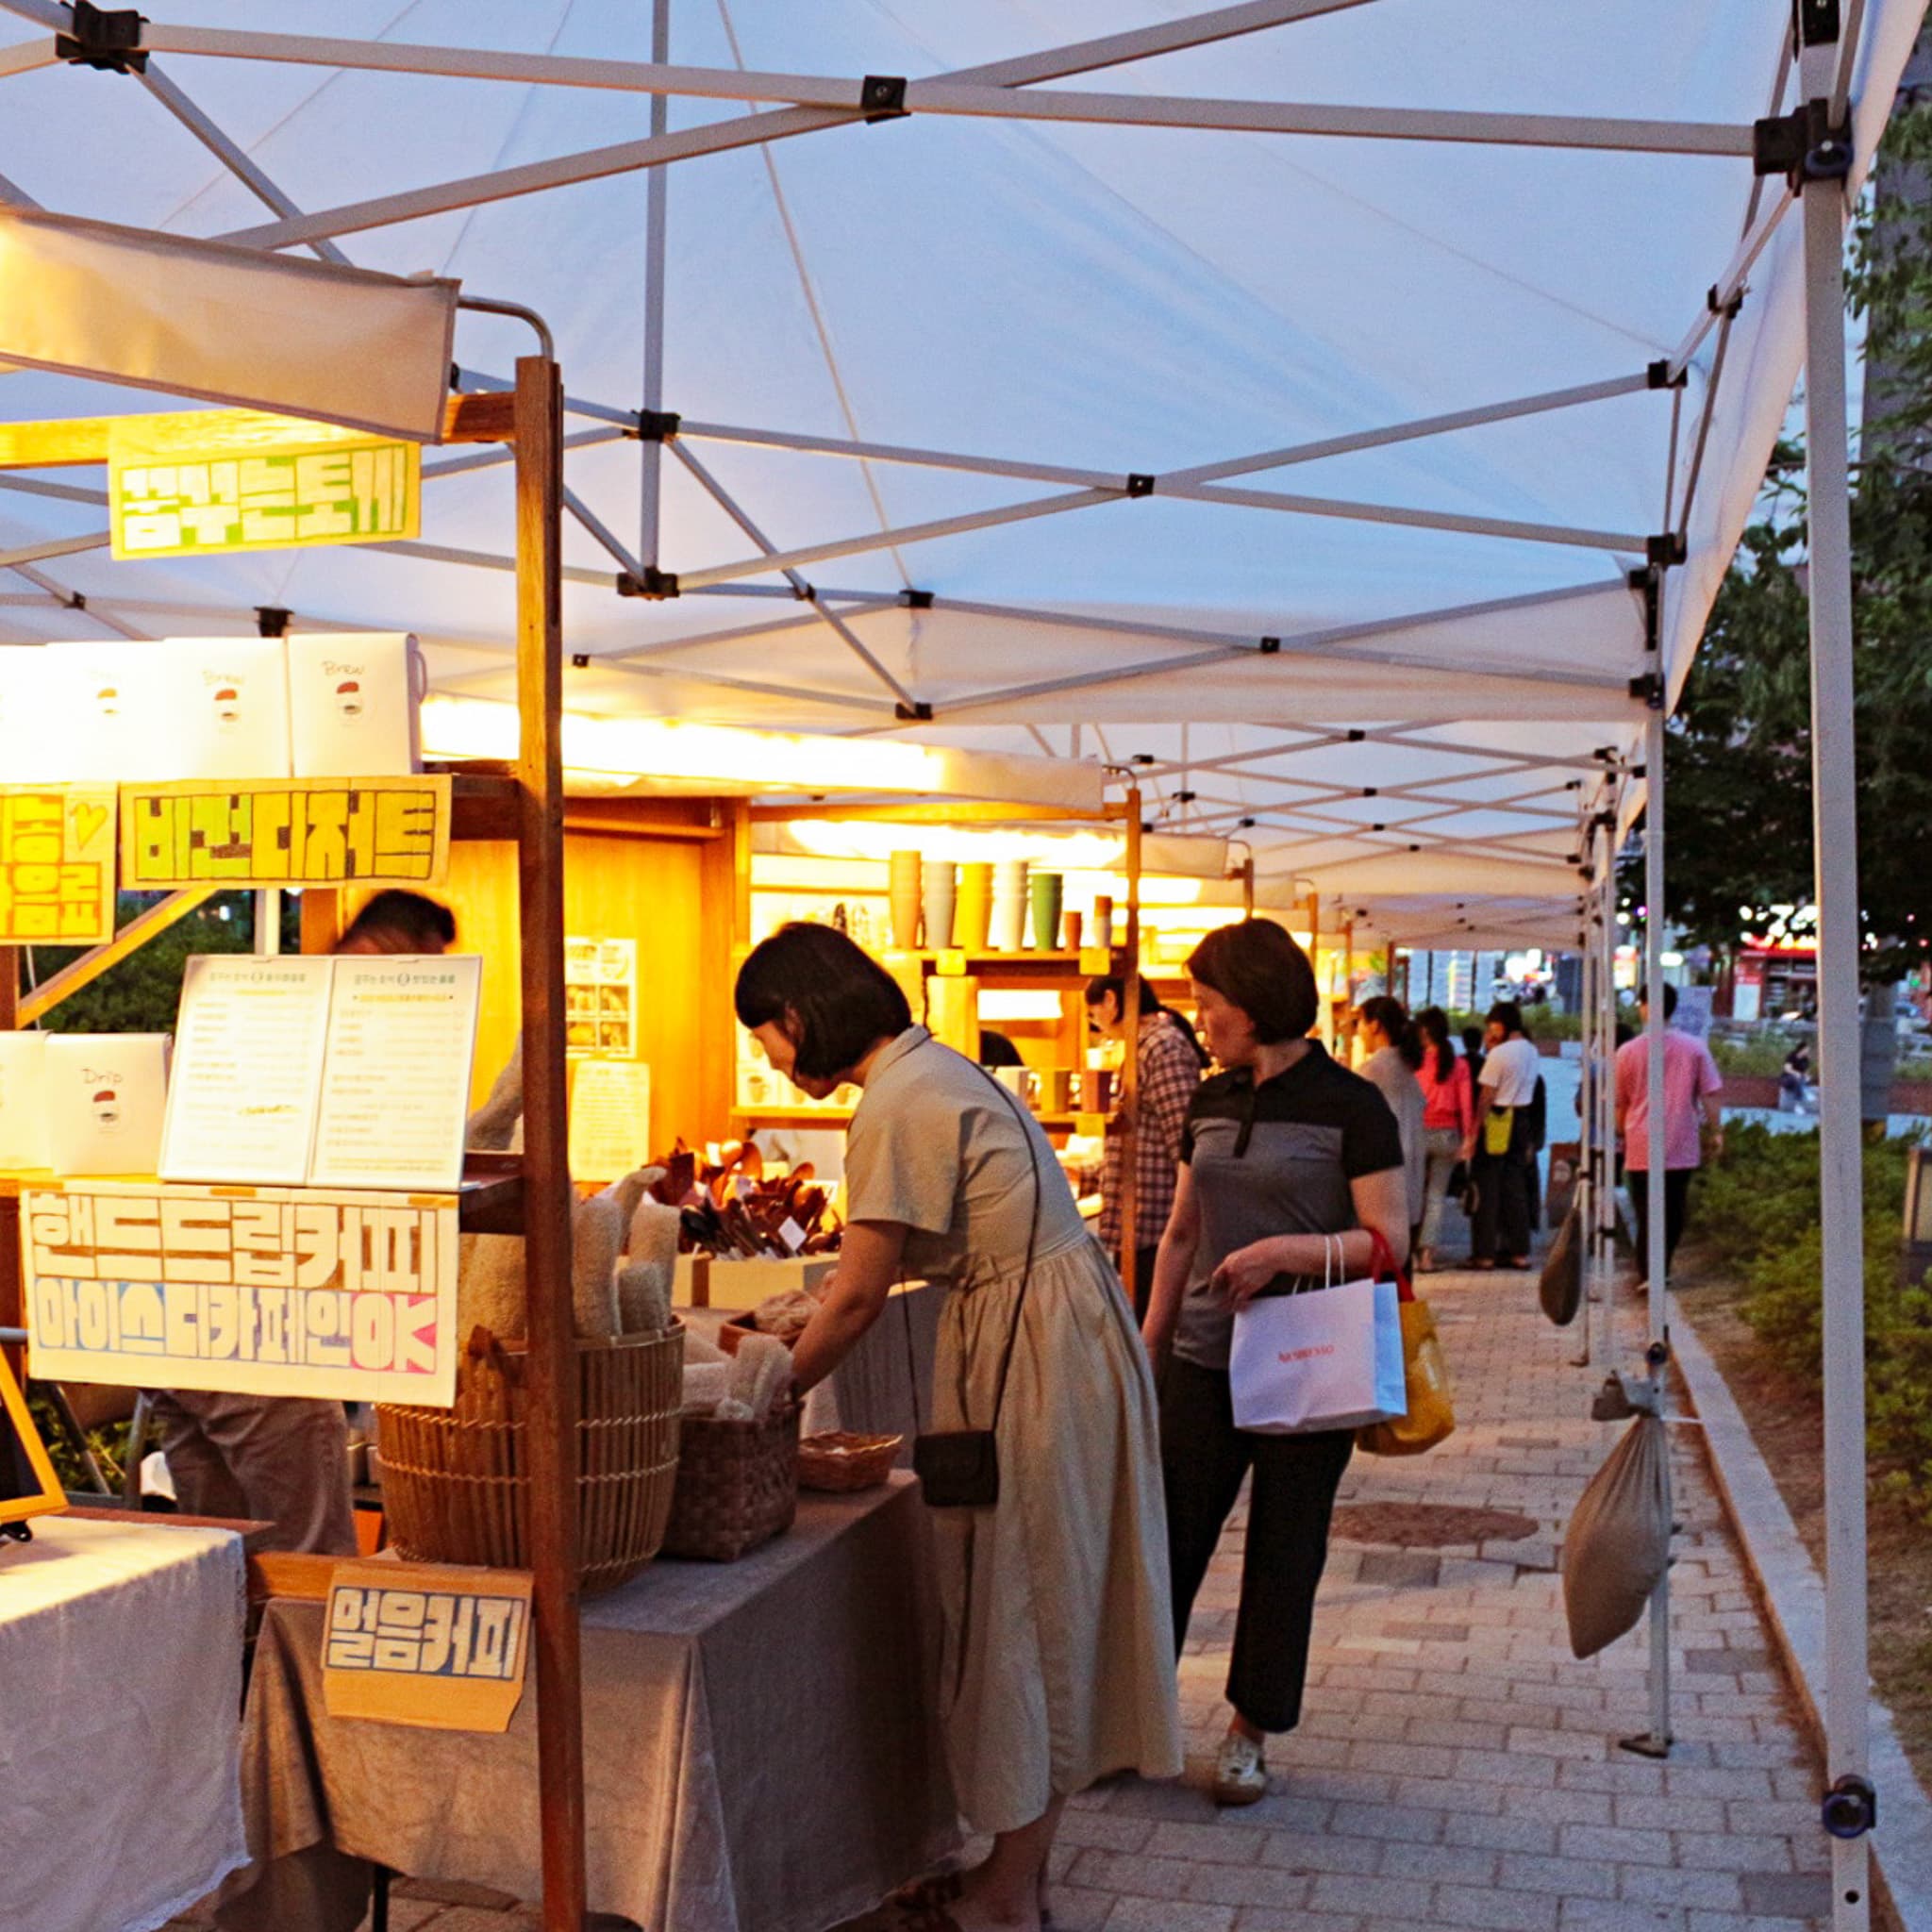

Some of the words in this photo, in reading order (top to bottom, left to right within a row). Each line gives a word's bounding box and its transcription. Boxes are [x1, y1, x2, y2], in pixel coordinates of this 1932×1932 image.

[322, 660, 365, 677] Brew
[80, 1068, 124, 1087] Drip
[325, 1586, 526, 1681] 얼음커피
